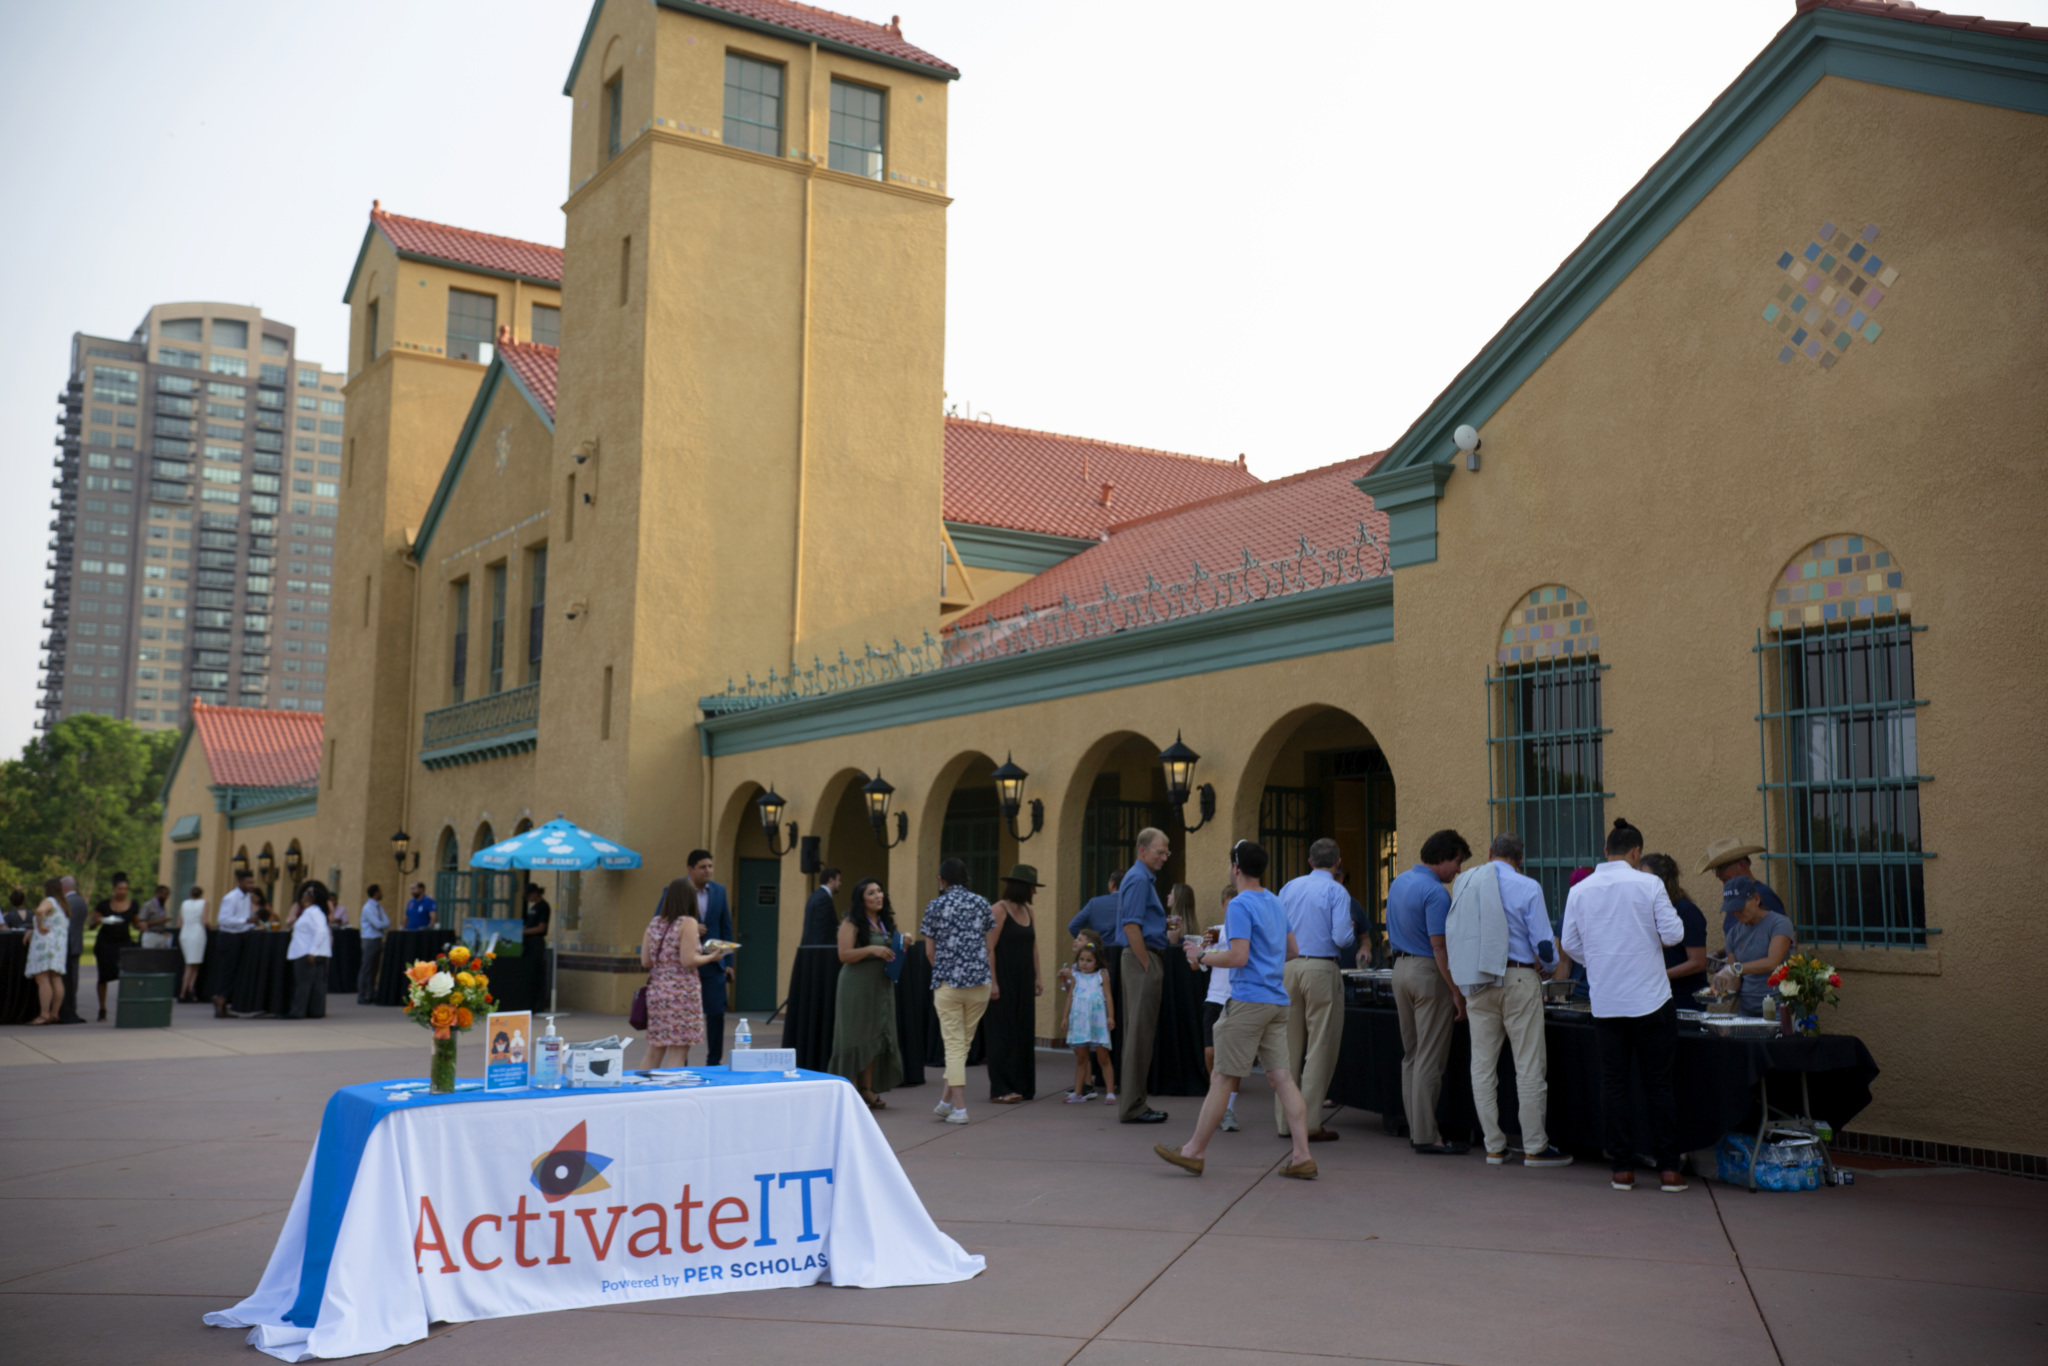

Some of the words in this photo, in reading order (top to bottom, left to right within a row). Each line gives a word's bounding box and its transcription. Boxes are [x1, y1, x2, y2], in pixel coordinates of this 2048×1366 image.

[413, 1168, 834, 1275] ActivateIT
[601, 1274, 660, 1293] Powered
[662, 1273, 680, 1288] by
[683, 1265, 724, 1284] PER
[729, 1252, 829, 1279] SCHOLAS
